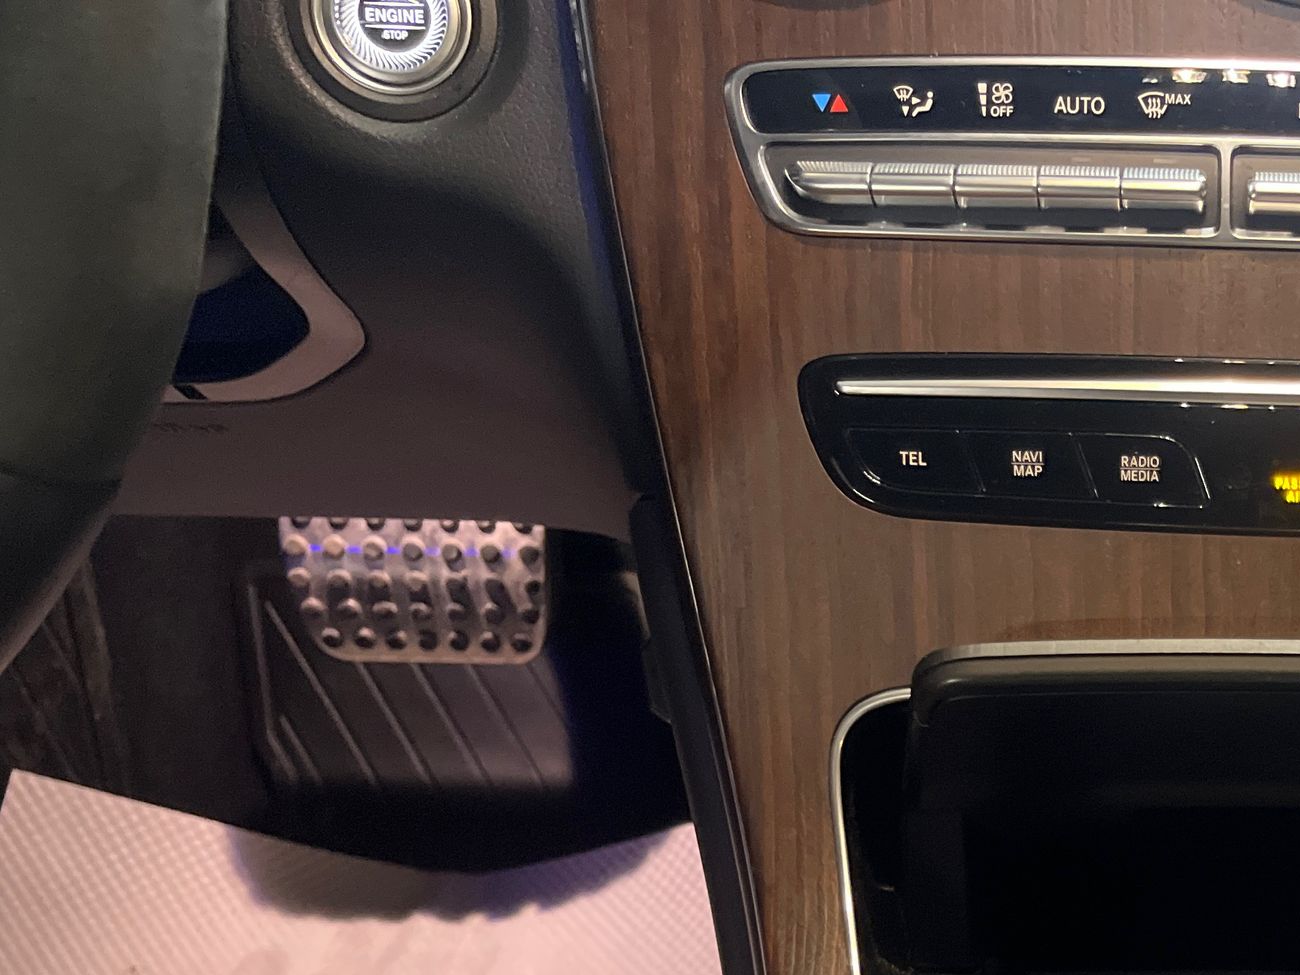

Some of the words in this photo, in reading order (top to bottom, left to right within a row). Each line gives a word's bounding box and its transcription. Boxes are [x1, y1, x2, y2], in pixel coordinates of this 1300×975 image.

[364, 6, 425, 24] ENGINE
[380, 28, 410, 41] STOP
[1053, 95, 1105, 116] AUTO
[1164, 92, 1192, 106] MAX
[990, 105, 1015, 119] OFF
[899, 450, 928, 467] TEL
[1011, 450, 1044, 464] NAVI
[1120, 455, 1160, 469] RADIO
[1013, 464, 1043, 477] MAP
[1120, 468, 1160, 482] MEDIA
